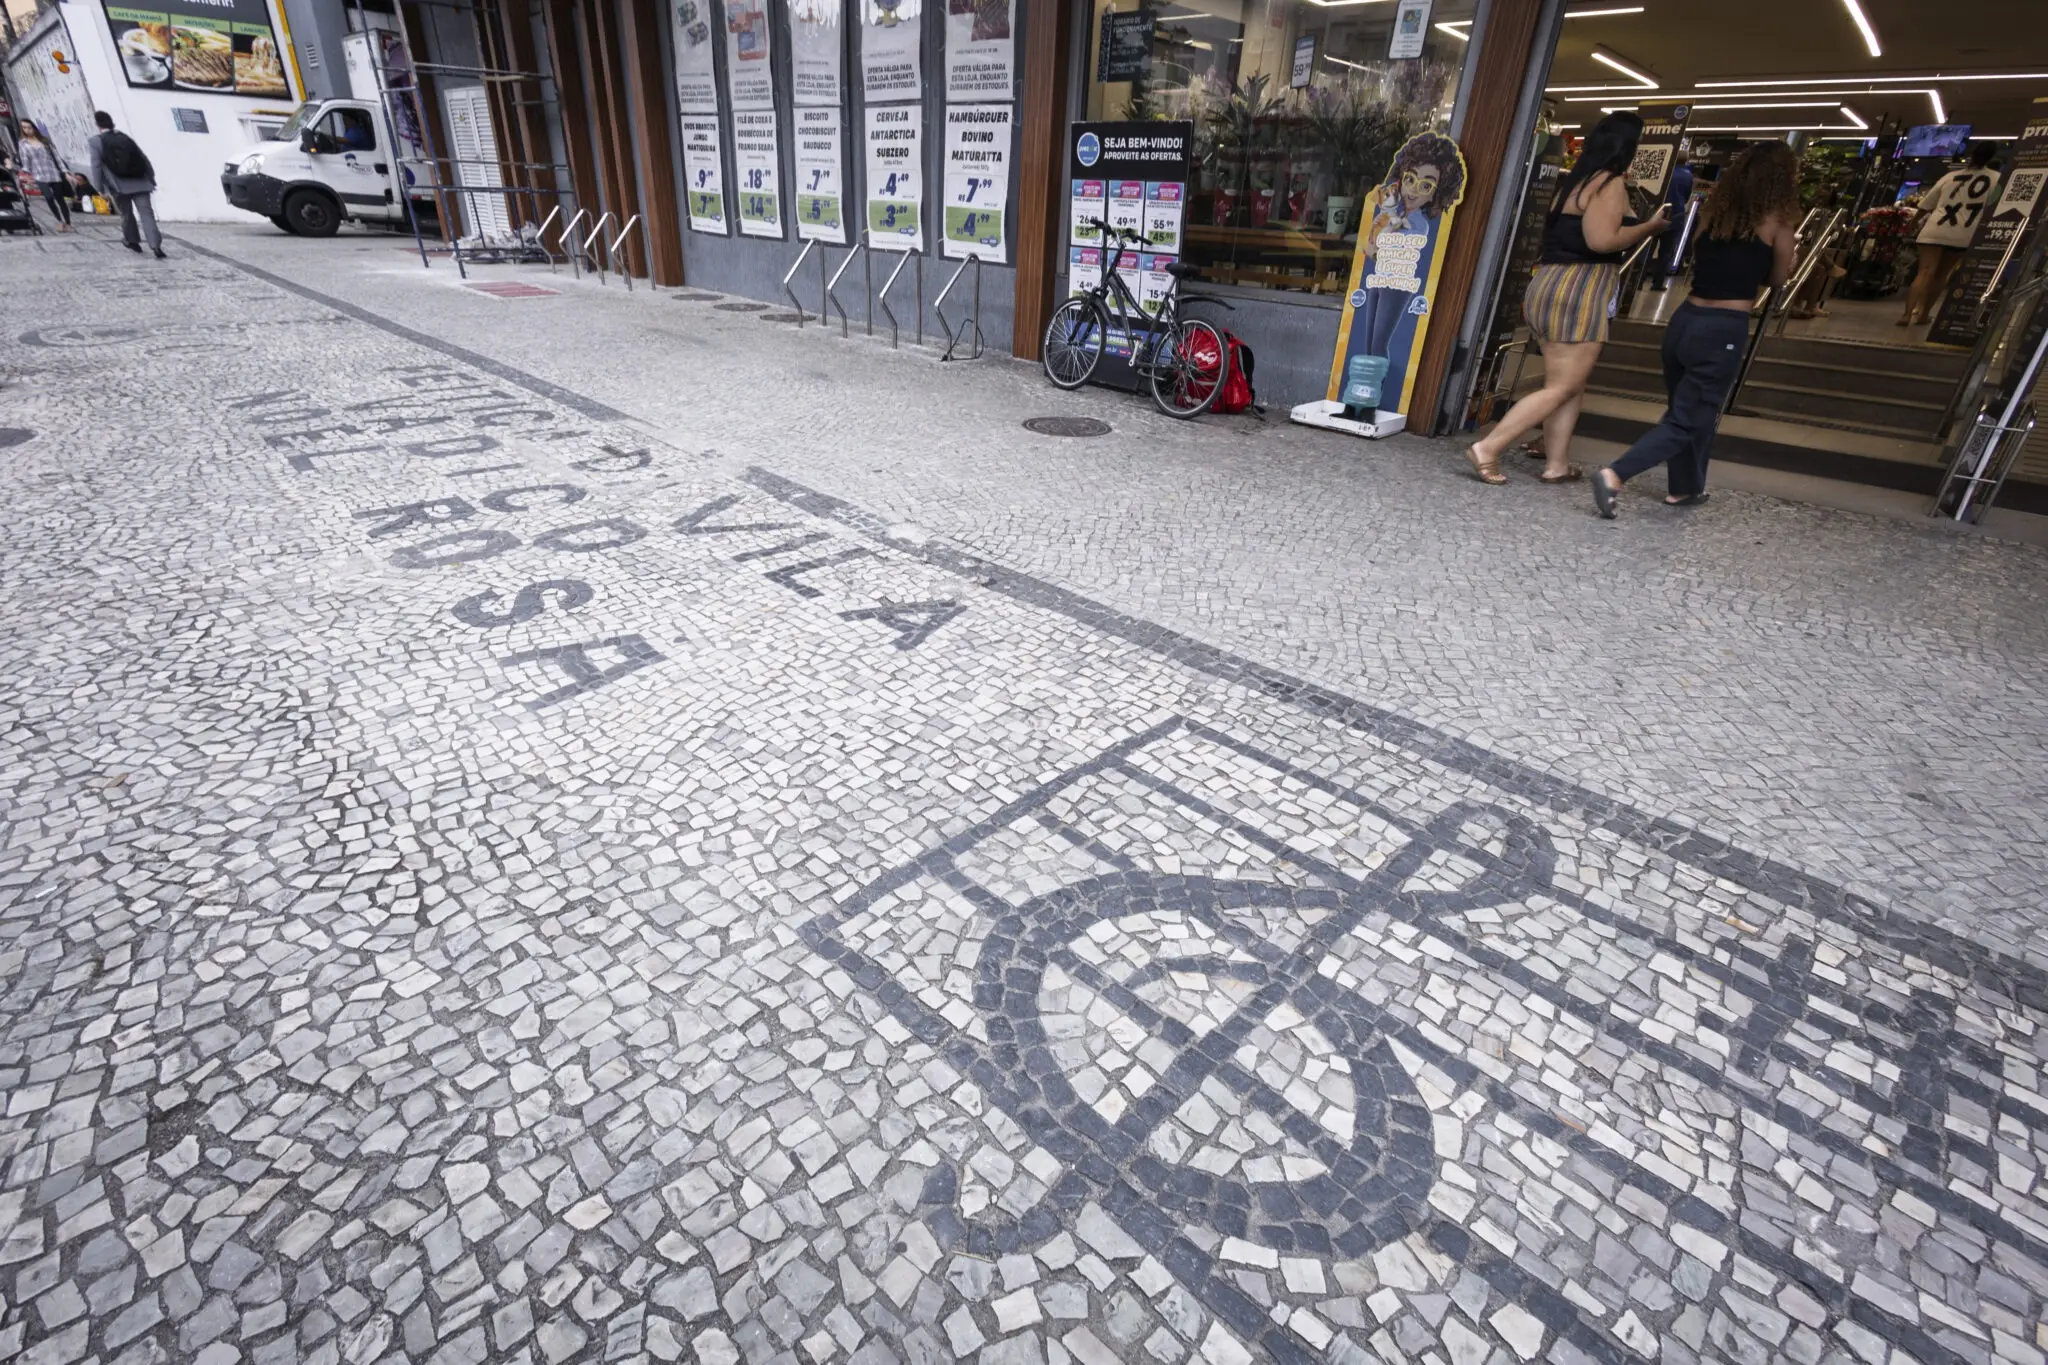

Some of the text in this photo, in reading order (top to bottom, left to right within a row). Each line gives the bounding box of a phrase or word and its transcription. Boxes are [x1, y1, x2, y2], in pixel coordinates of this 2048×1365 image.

[953, 63, 1006, 73] OFERTA VÁLIDA PARA
[980, 72, 1008, 81] ENQUANTO
[804, 112, 828, 121] BISCOITO
[876, 111, 908, 123] CERVEJA
[949, 109, 1008, 123] HAMBÚRGUER
[798, 127, 836, 136] CHOCOBISCUIT
[870, 129, 915, 141] ANTARCTICA
[1642, 124, 1680, 135] rime
[962, 132, 993, 143] BOVINO
[1104, 138, 1183, 148] SEJA BEM-VINDO!
[803, 142, 831, 150] BAUDUCCO
[876, 148, 908, 158] SUBZERO
[952, 151, 1002, 163] MATURATTA
[1104, 152, 1183, 161] APROVEITE AS OFERTAS.
[886, 173, 909, 196] 4,49
[966, 178, 992, 202] 7,99
[964, 212, 990, 237] 4,99
[1154, 220, 1174, 229] 55,99
[1404, 236, 1425, 246] SEU
[1385, 262, 1415, 274] SUPER
[1368, 277, 1418, 292] BEM-VINDO!
[673, 494, 968, 651] VILA
[350, 495, 668, 711] ROSA
